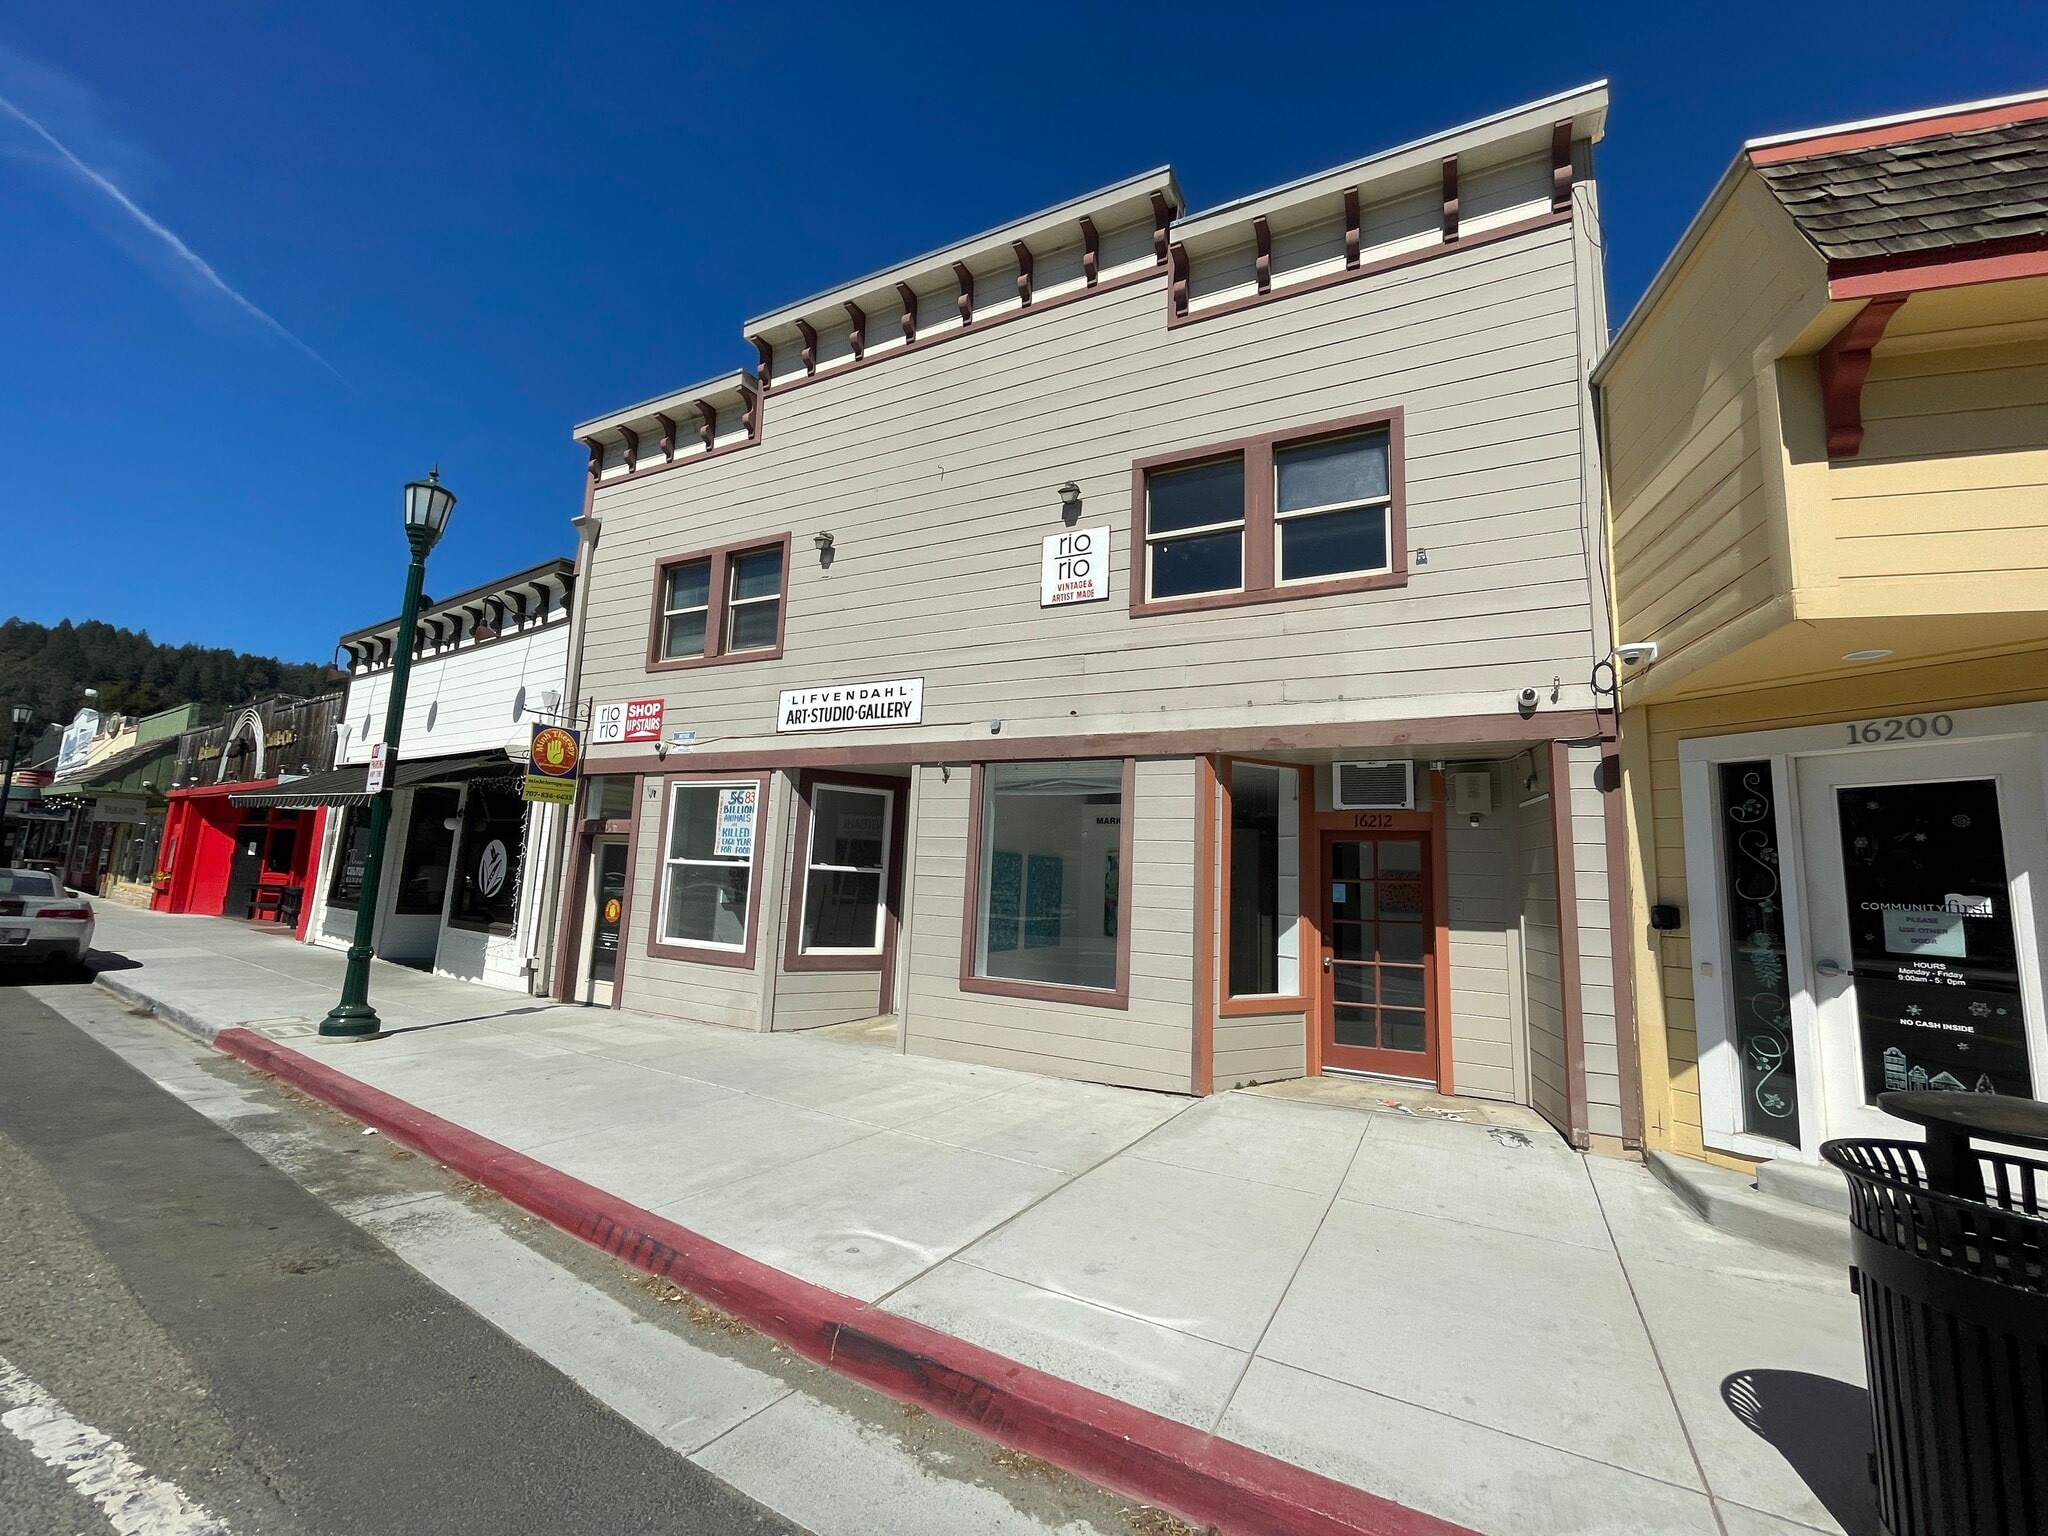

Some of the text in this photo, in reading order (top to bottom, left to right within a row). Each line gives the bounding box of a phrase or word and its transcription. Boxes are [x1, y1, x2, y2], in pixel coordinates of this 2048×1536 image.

[1060, 534, 1091, 555] rio
[1059, 559, 1090, 580] rio
[1052, 589, 1095, 602] ARTIST MADE
[792, 686, 907, 705] LIFVENDAHL
[601, 706, 620, 721] rio
[628, 703, 661, 717] SHOP
[600, 724, 619, 738] rio
[626, 718, 660, 732] UPSTAIRS
[1846, 714, 1953, 745] 16200
[536, 730, 575, 757] Minh Therapy
[723, 804, 754, 814] BILLION
[723, 814, 751, 823] ANIMALS
[1354, 813, 1393, 828] 16212
[722, 827, 750, 837] KILLED
[736, 838, 752, 847] YEAR
[721, 846, 751, 854] FOR FOOD
[1861, 900, 1992, 914] COMMUNITY first
[1906, 916, 1939, 924] PLEASE
[1917, 927, 1949, 935] OTHER
[1913, 962, 1946, 970] HOURS
[1897, 974, 1928, 983] 9:00am
[1898, 968, 1930, 977] Monday
[1937, 970, 1964, 979] Friday
[1900, 1018, 1975, 1033] NO CASH INSIDE
